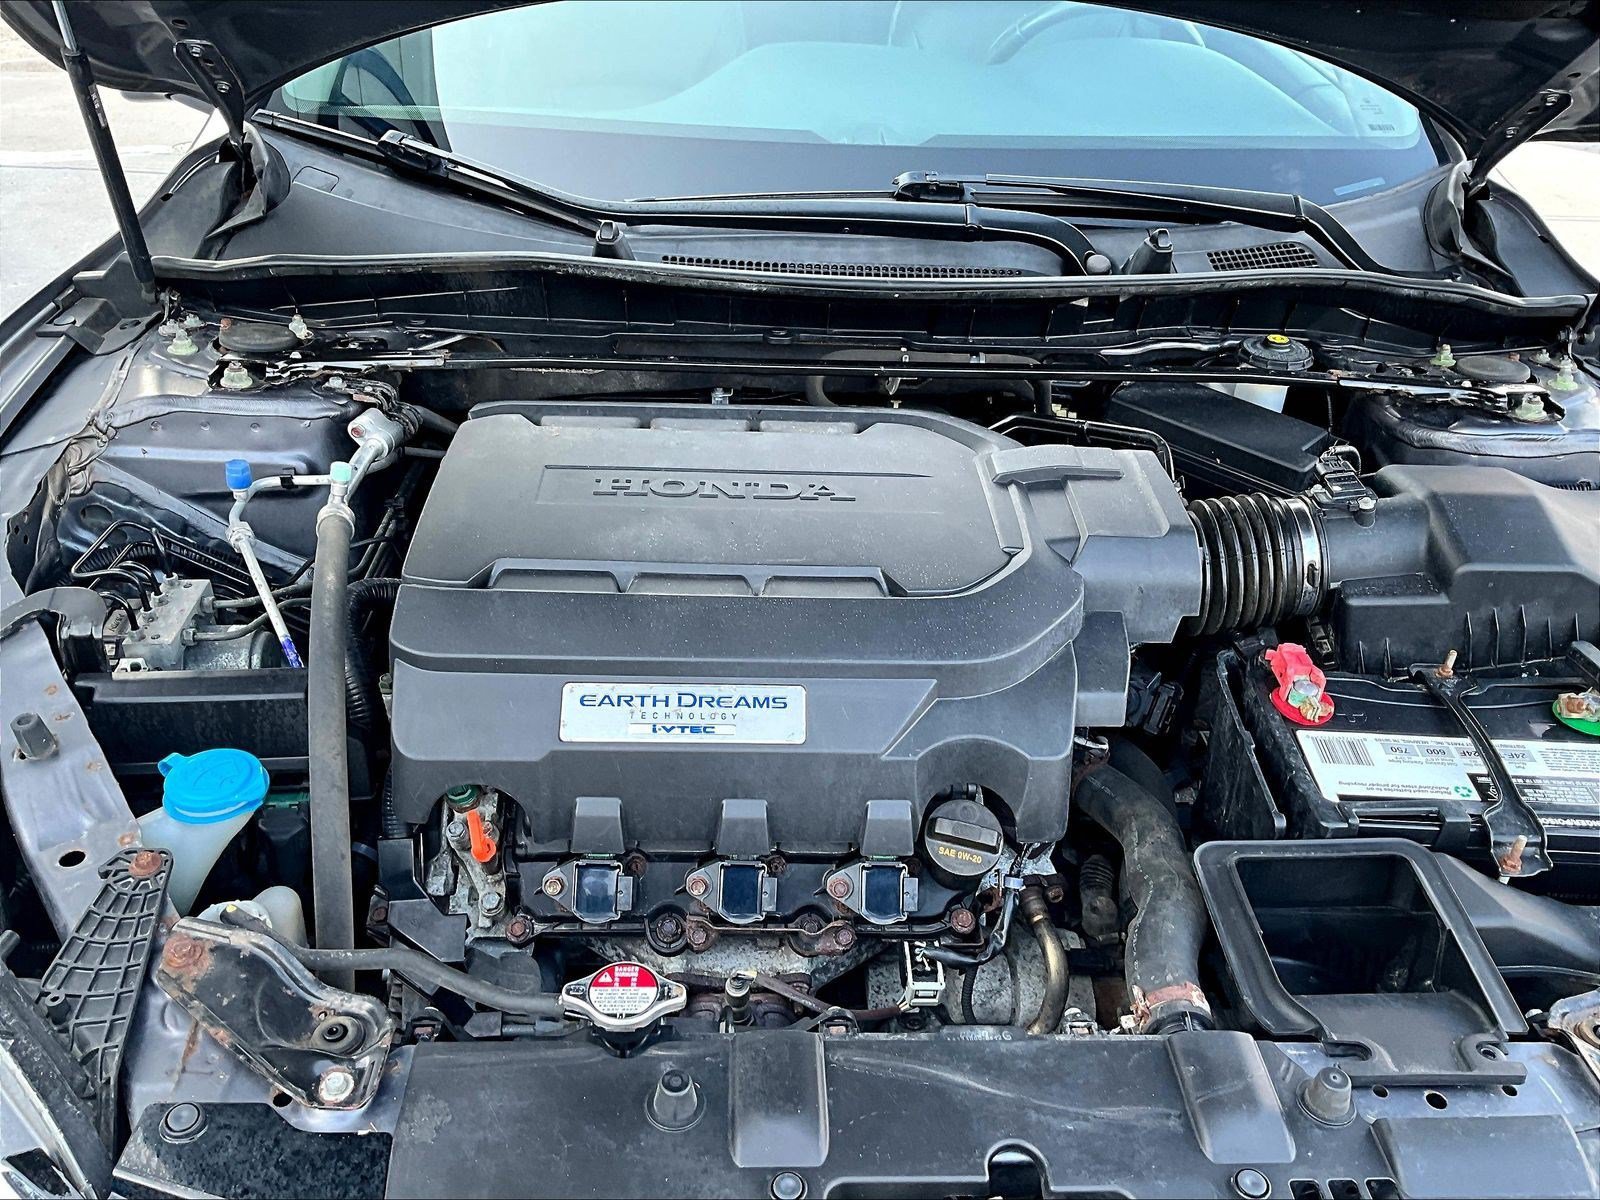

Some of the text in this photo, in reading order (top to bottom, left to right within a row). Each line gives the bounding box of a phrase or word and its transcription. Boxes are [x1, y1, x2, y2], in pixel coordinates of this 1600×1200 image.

[593, 478, 856, 501] HONDA
[579, 693, 788, 709] EARTH DREAMS
[629, 711, 738, 720] TECHNOLOGY
[1390, 746, 1409, 754] 750
[1426, 748, 1446, 756] 600
[938, 846, 982, 864] SAE 0W-20
